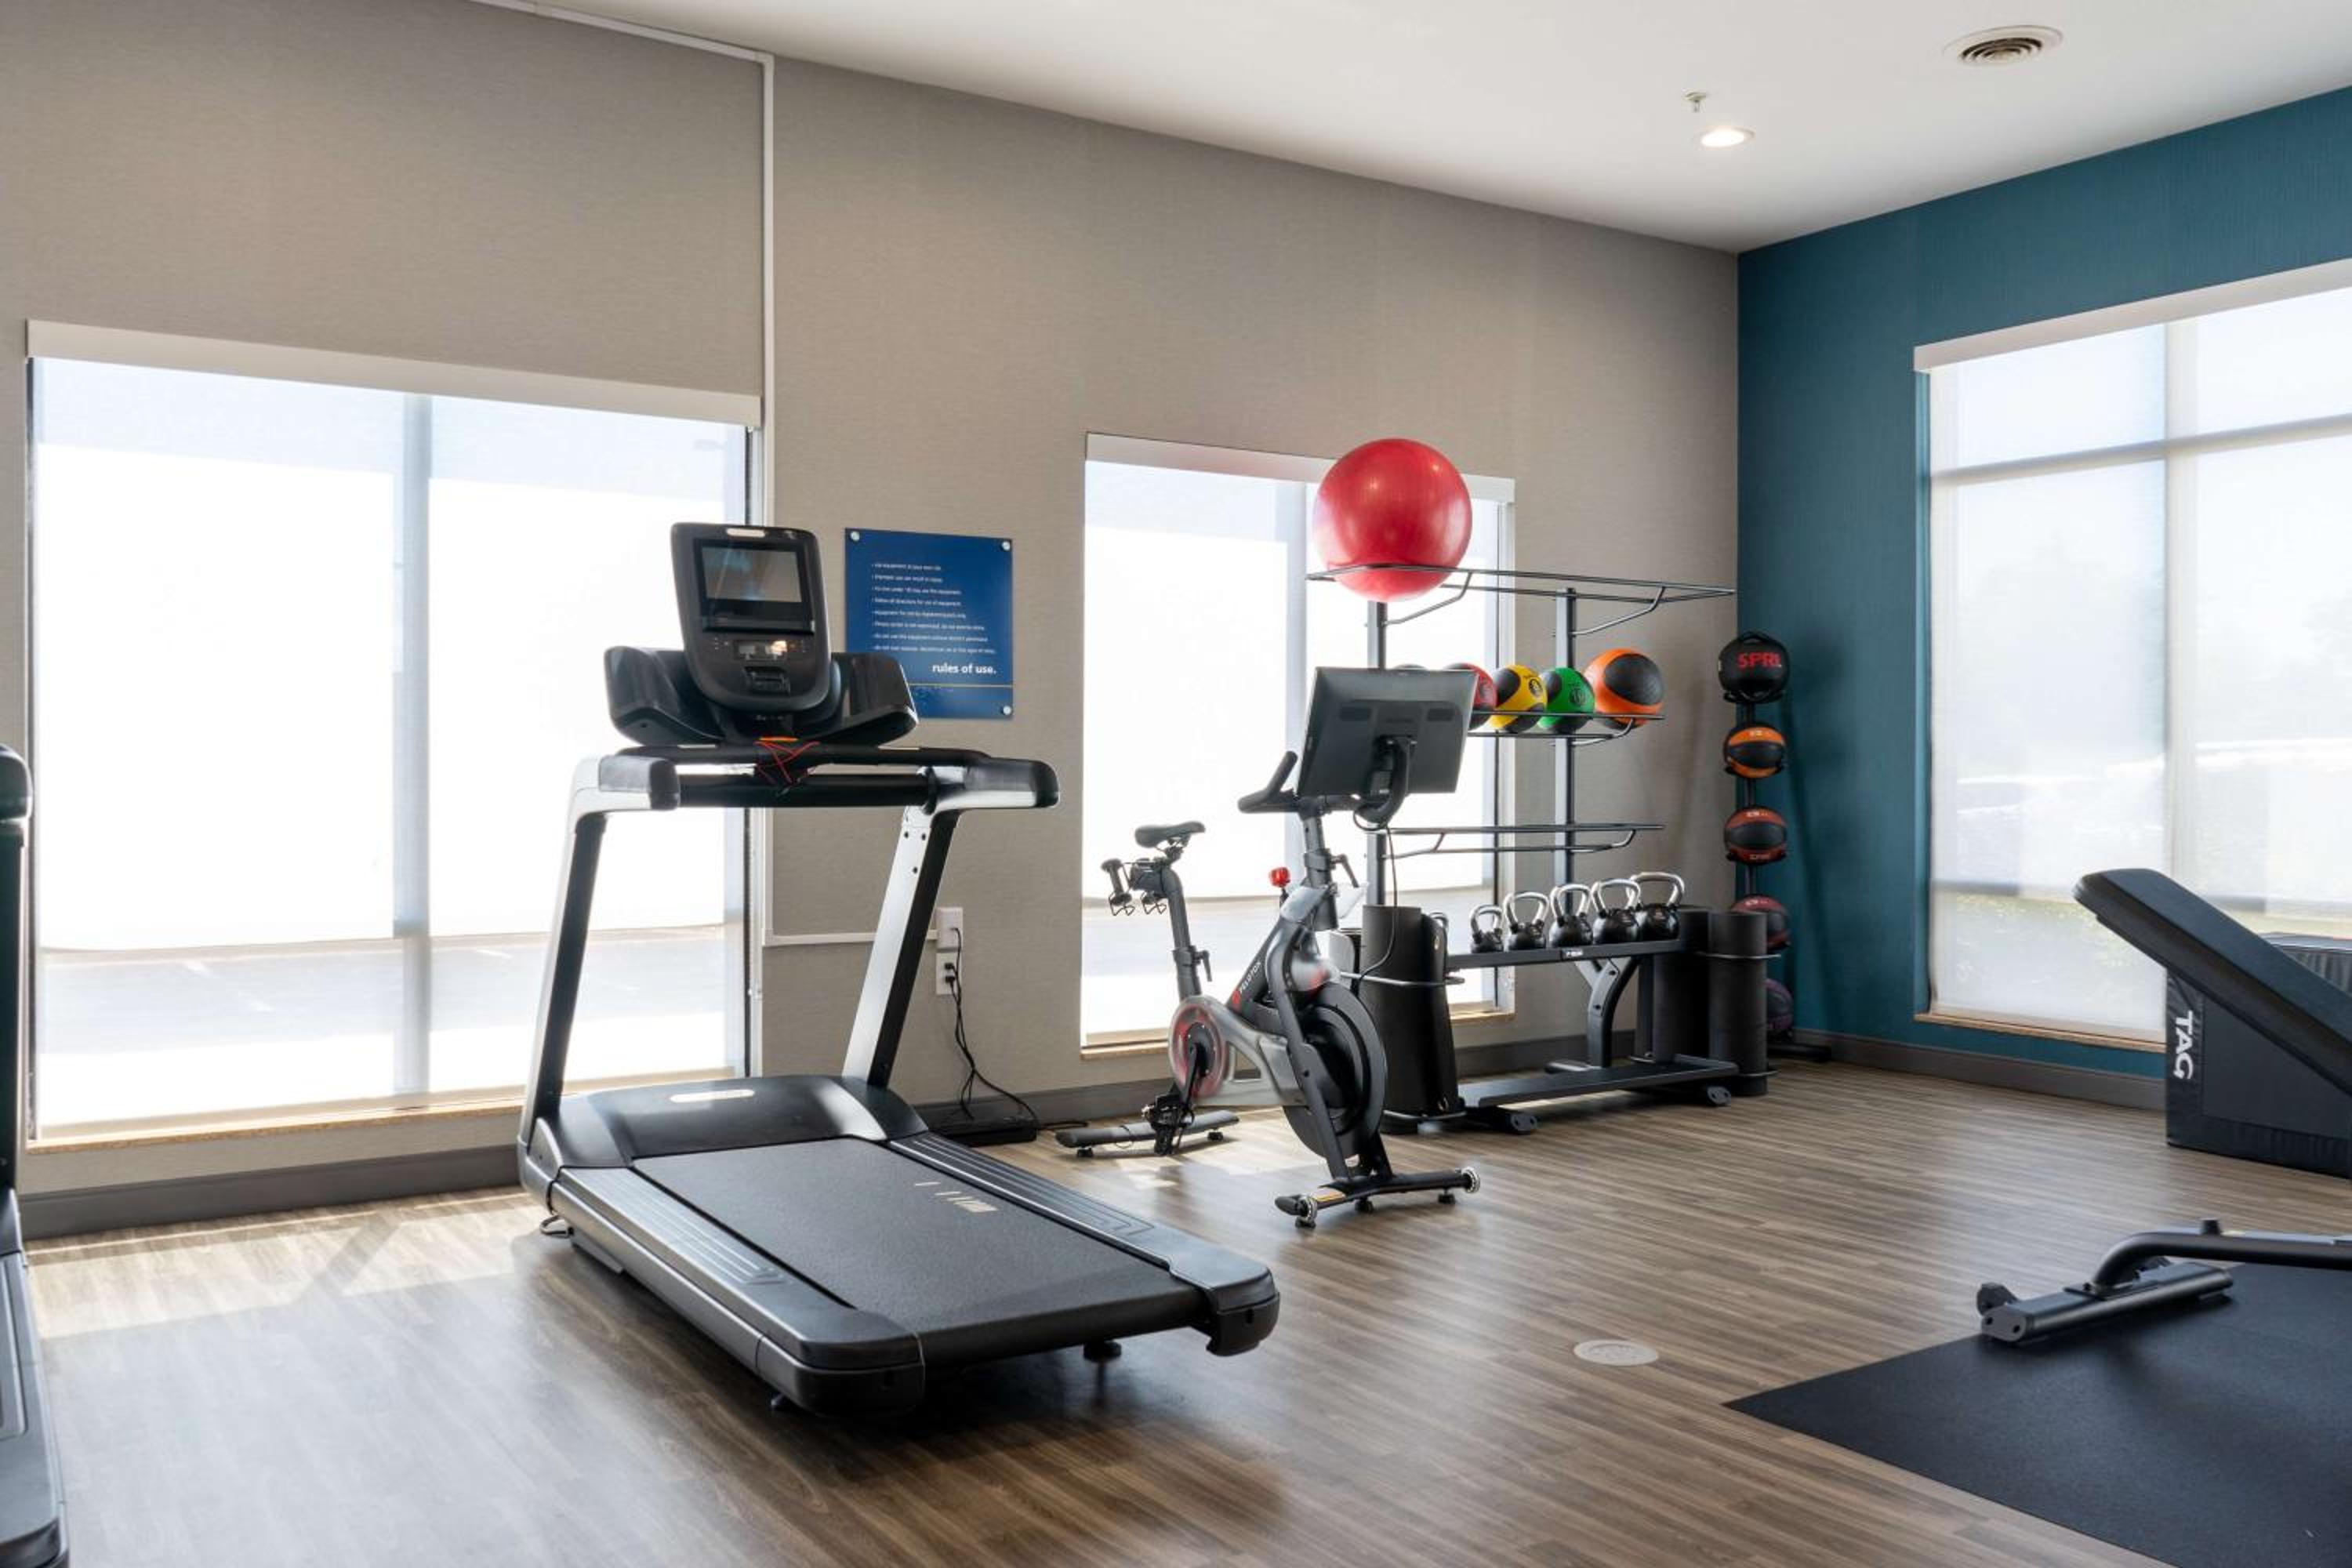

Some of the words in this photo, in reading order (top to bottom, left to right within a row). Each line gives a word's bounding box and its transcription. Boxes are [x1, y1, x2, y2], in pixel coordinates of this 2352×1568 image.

[932, 662, 959, 673] rules
[961, 662, 973, 674] of
[975, 665, 996, 675] use.
[2173, 1009, 2194, 1080] TAG
